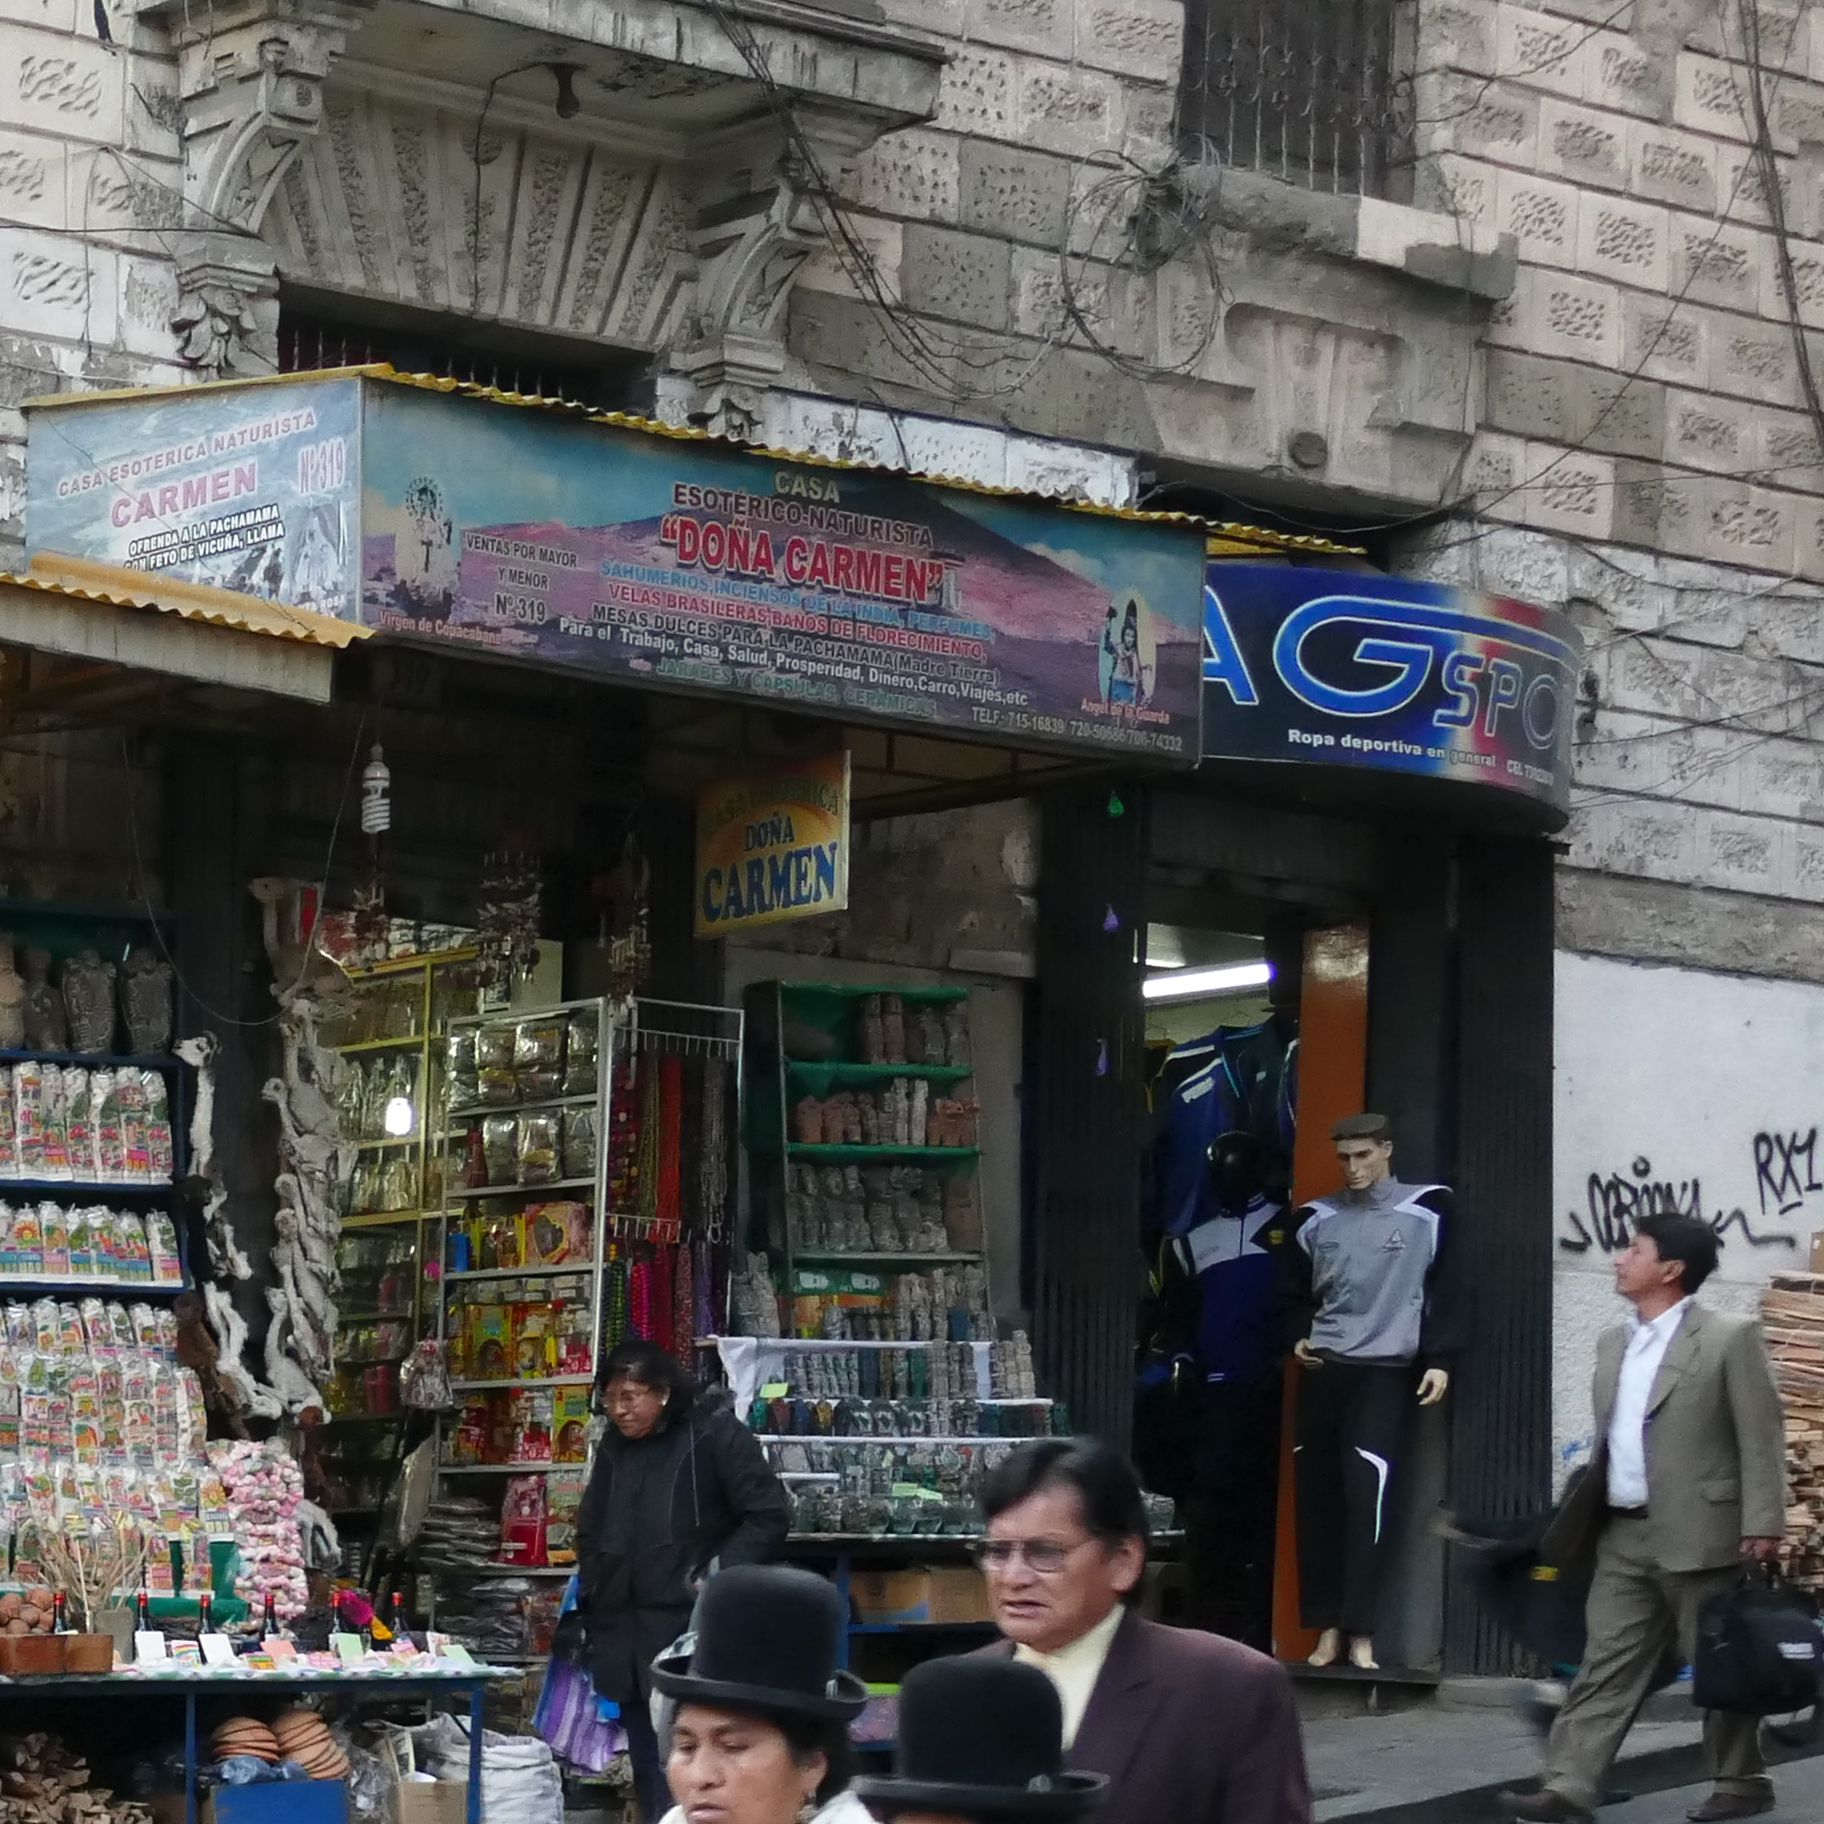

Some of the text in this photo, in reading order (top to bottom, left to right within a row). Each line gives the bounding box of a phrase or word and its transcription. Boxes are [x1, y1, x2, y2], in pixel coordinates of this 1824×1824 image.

[58, 410, 316, 498] CASA ESOTERICA NATURISTA
[111, 463, 257, 528] CARMEN
[774, 470, 841, 503] CASA
[128, 528, 178, 557] OFRENDA
[193, 521, 209, 542] LA
[210, 503, 280, 537] PACHAMAMA
[149, 549, 179, 571] FETO
[180, 543, 196, 562] DE
[247, 520, 286, 545] LLAMA
[466, 532, 579, 569] VENTAS POR MAYOR
[498, 568, 550, 591] Y MENOR
[378, 608, 416, 632] Virgen
[418, 617, 434, 633] de
[517, 597, 547, 623] 319
[593, 604, 650, 628] MESAS
[654, 613, 717, 639] DULCES
[723, 624, 765, 645] PARA
[768, 633, 789, 650] LA
[609, 583, 661, 607] VELAS
[831, 619, 854, 638] DE
[559, 617, 593, 639] Para
[597, 623, 612, 641] el
[620, 627, 679, 656] Trabajo,
[683, 637, 725, 661] Casa,
[727, 645, 773, 669] Salud,
[775, 652, 866, 684] Prosperidad,
[1288, 728, 1335, 748] Ropa
[1341, 736, 1423, 758] deportiva
[1427, 743, 1445, 759] en
[1451, 748, 1496, 768] general
[703, 840, 838, 923] CARMEN
